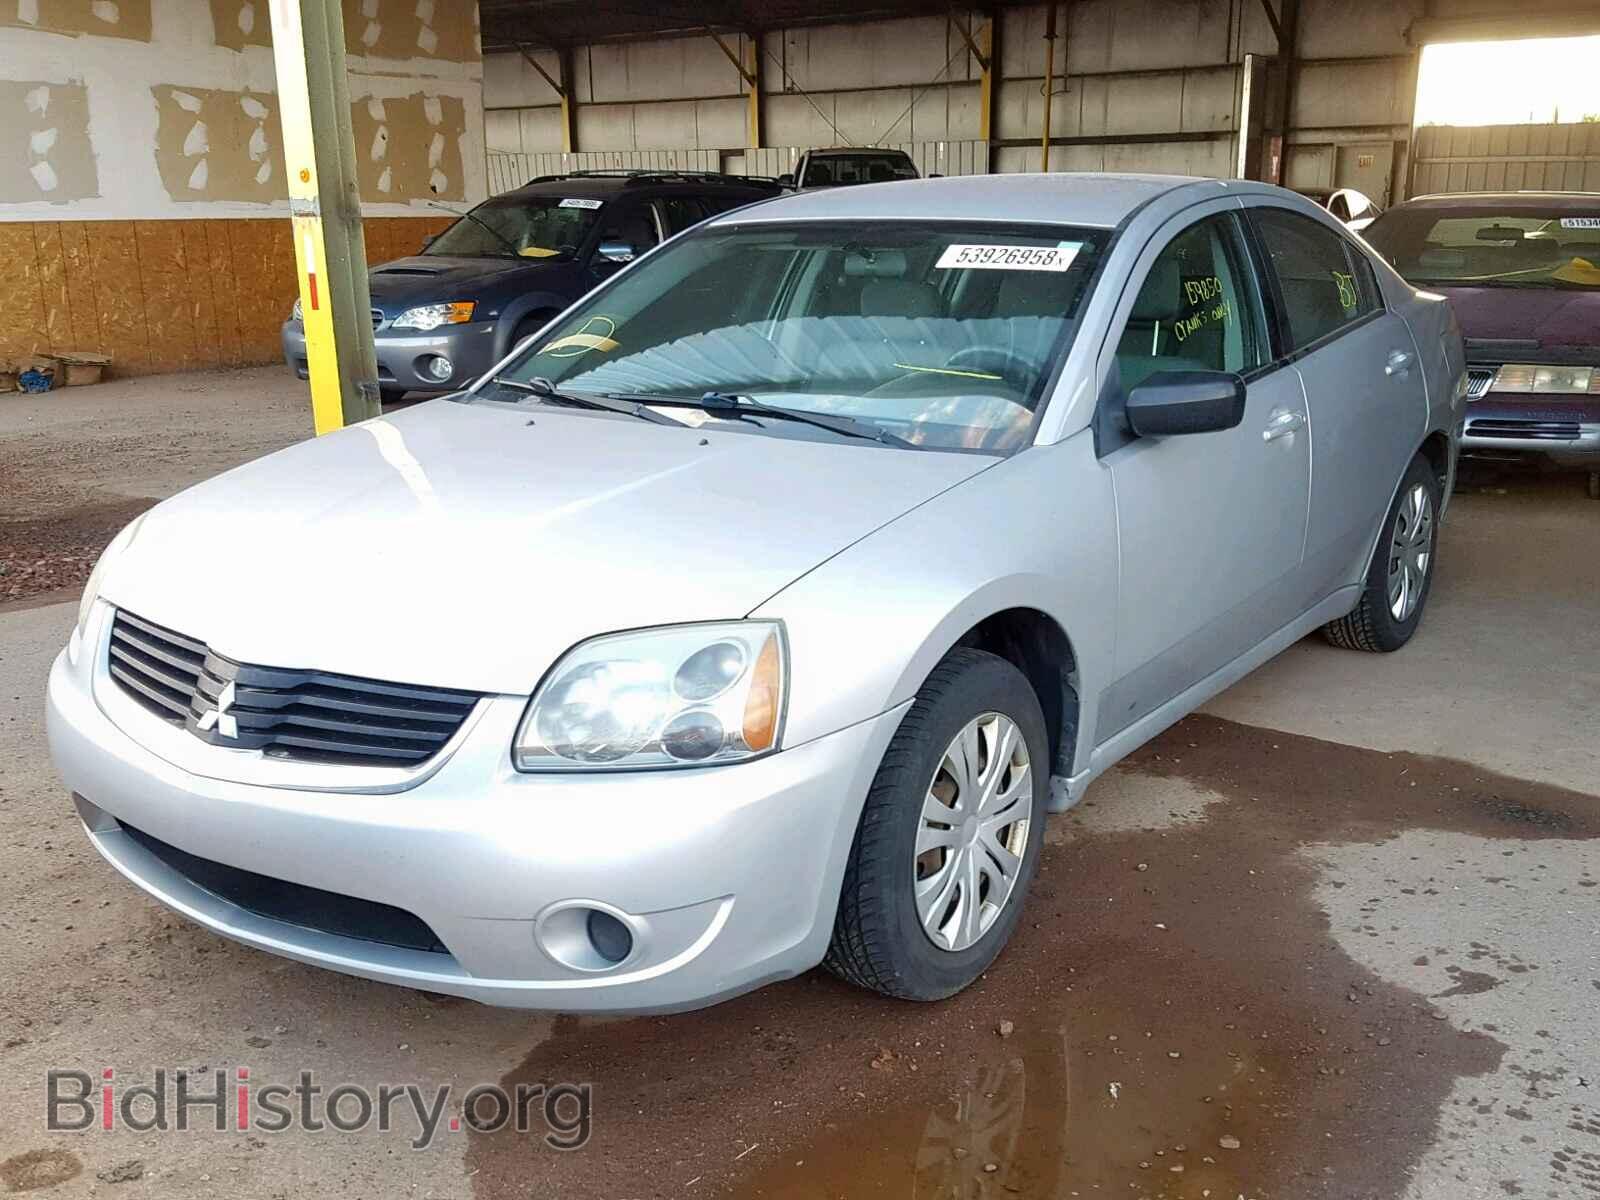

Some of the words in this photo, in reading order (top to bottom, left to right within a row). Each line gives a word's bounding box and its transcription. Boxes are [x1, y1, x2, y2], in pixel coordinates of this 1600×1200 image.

[1568, 218, 1600, 227] 51534
[956, 247, 1058, 265] 53926958
[1184, 277, 1222, 306] 159850
